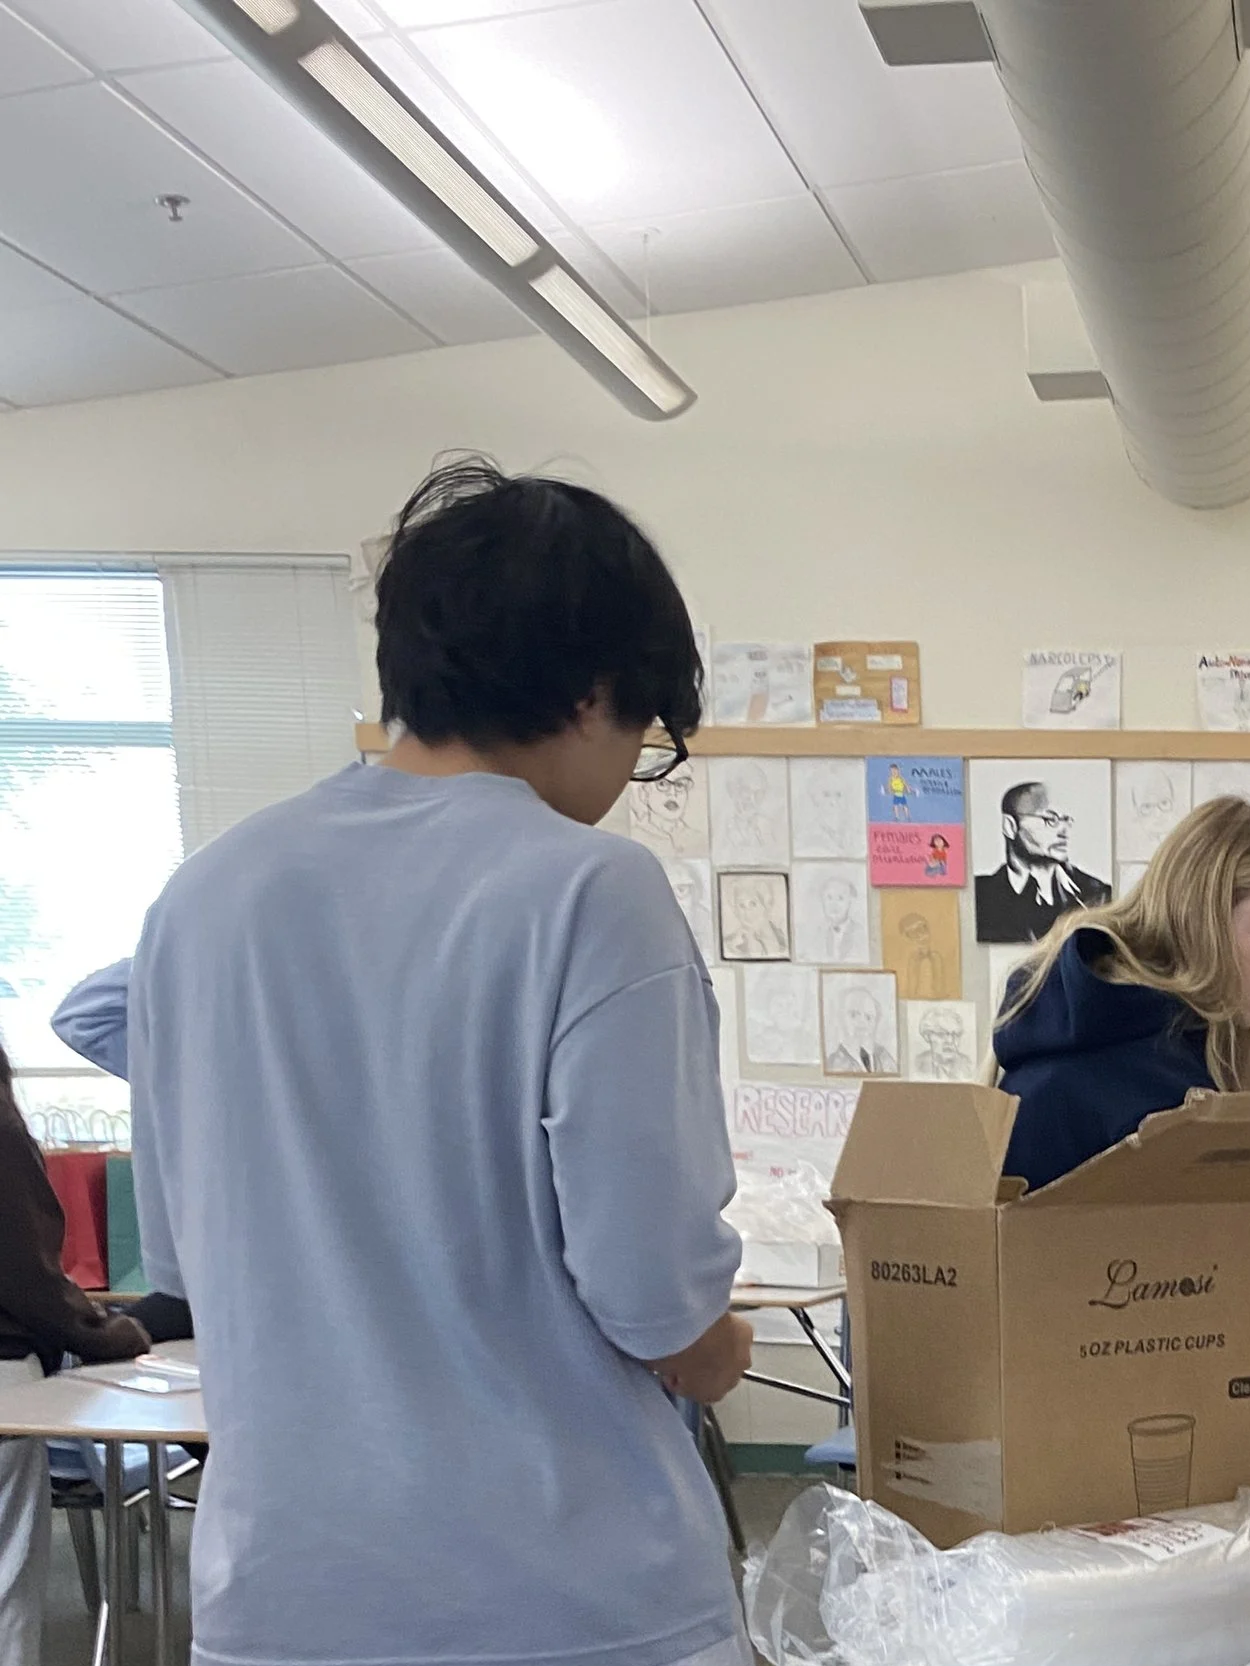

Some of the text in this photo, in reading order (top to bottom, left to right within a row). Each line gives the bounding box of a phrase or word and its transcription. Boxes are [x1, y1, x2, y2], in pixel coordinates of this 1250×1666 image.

[871, 1260, 958, 1288] 80263LA2
[1088, 1259, 1219, 1310] Lamosi
[1114, 1336, 1181, 1355] PLASTIC
[1184, 1333, 1226, 1350] CUPS
